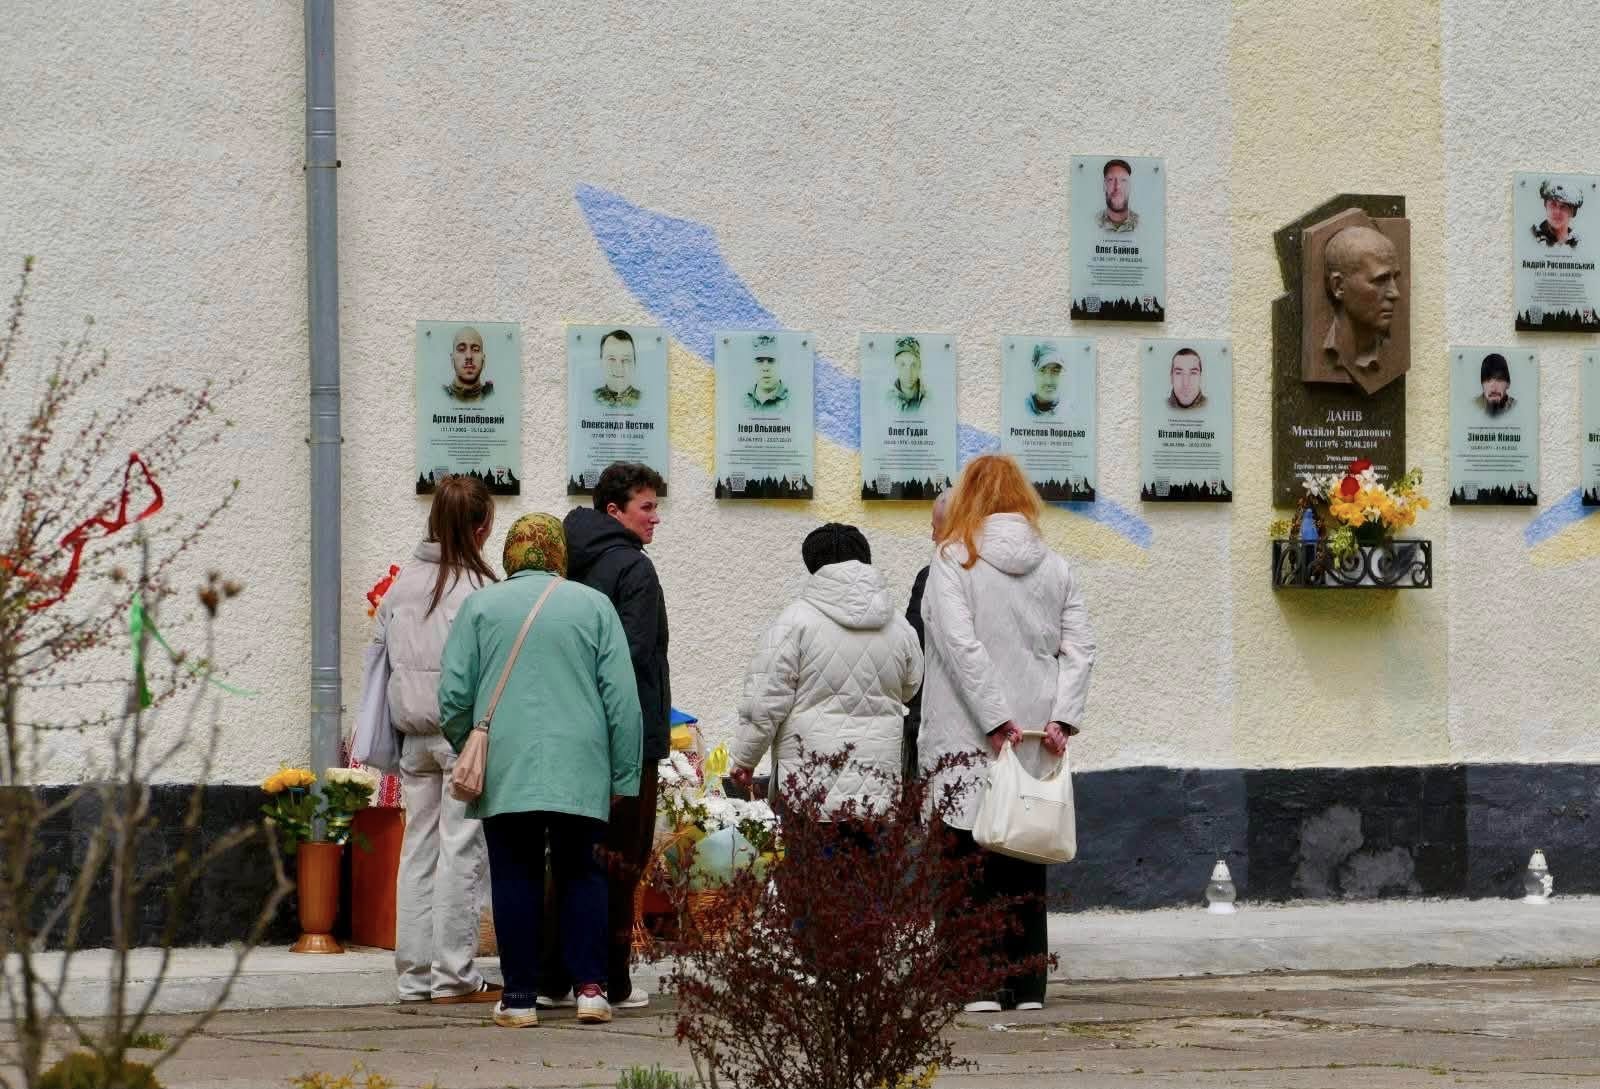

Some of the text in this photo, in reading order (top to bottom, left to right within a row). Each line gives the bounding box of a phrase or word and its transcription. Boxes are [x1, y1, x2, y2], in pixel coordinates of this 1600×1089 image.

[1095, 245, 1112, 254] Олег
[1522, 260, 1546, 269] Андрій
[432, 414, 457, 424] Артем
[1326, 410, 1363, 422] ДАНІВ
[581, 420, 654, 430] Олександр Костюк
[738, 423, 791, 433] Ігор Ольхович
[888, 427, 905, 436] Олег
[1010, 427, 1086, 438] Ростислав Породько
[1158, 429, 1215, 439] Віталій Поліщук
[1292, 425, 1392, 438] Михайло Богданович
[1467, 432, 1496, 442] Зіновій
